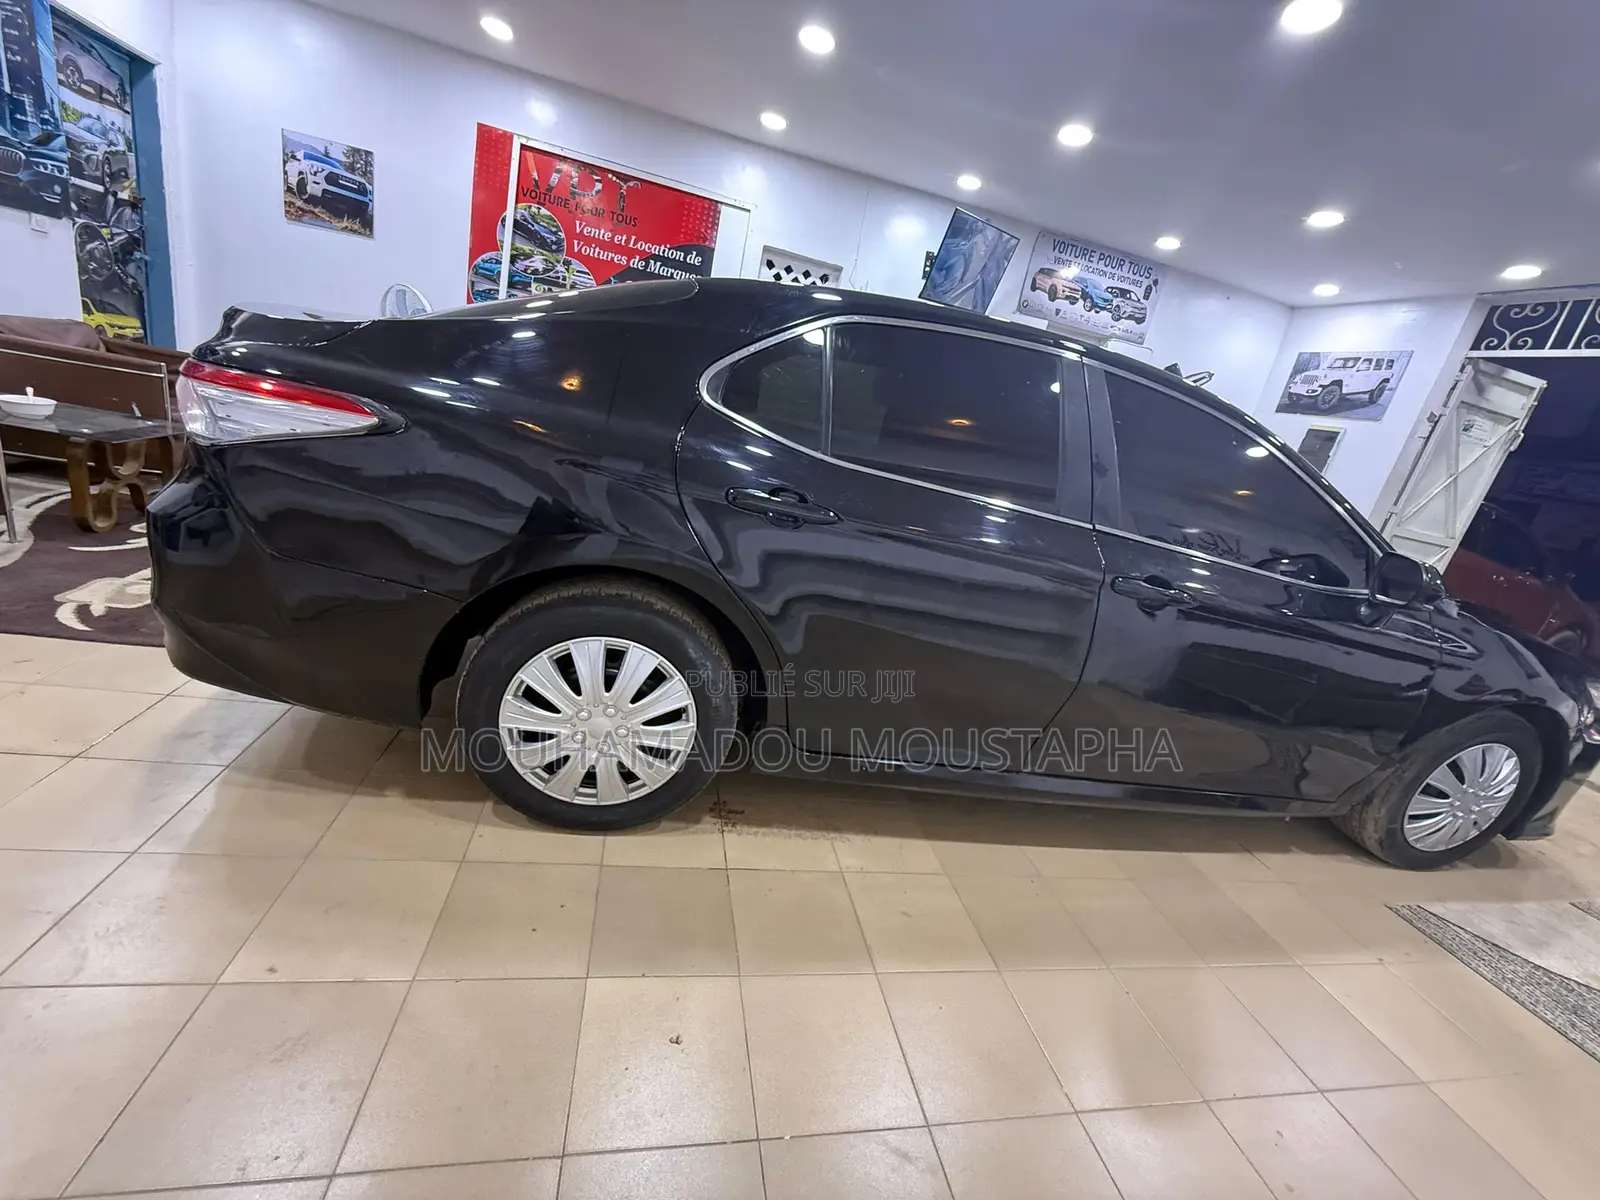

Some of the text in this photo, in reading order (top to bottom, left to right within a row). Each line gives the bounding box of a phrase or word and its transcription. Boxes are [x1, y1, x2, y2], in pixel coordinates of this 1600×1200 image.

[521, 186, 571, 209] VOITURE
[610, 211, 638, 228] TOUS
[573, 240, 702, 280] Voitures de Marque
[575, 220, 703, 266] Vente et Location de
[1052, 238, 1153, 280] VOITURE POUR TOUS
[1054, 256, 1072, 268] VENTE
[1081, 264, 1108, 278] LOCATION
[1107, 271, 1116, 281] DE
[1116, 275, 1143, 288] VOITURES
